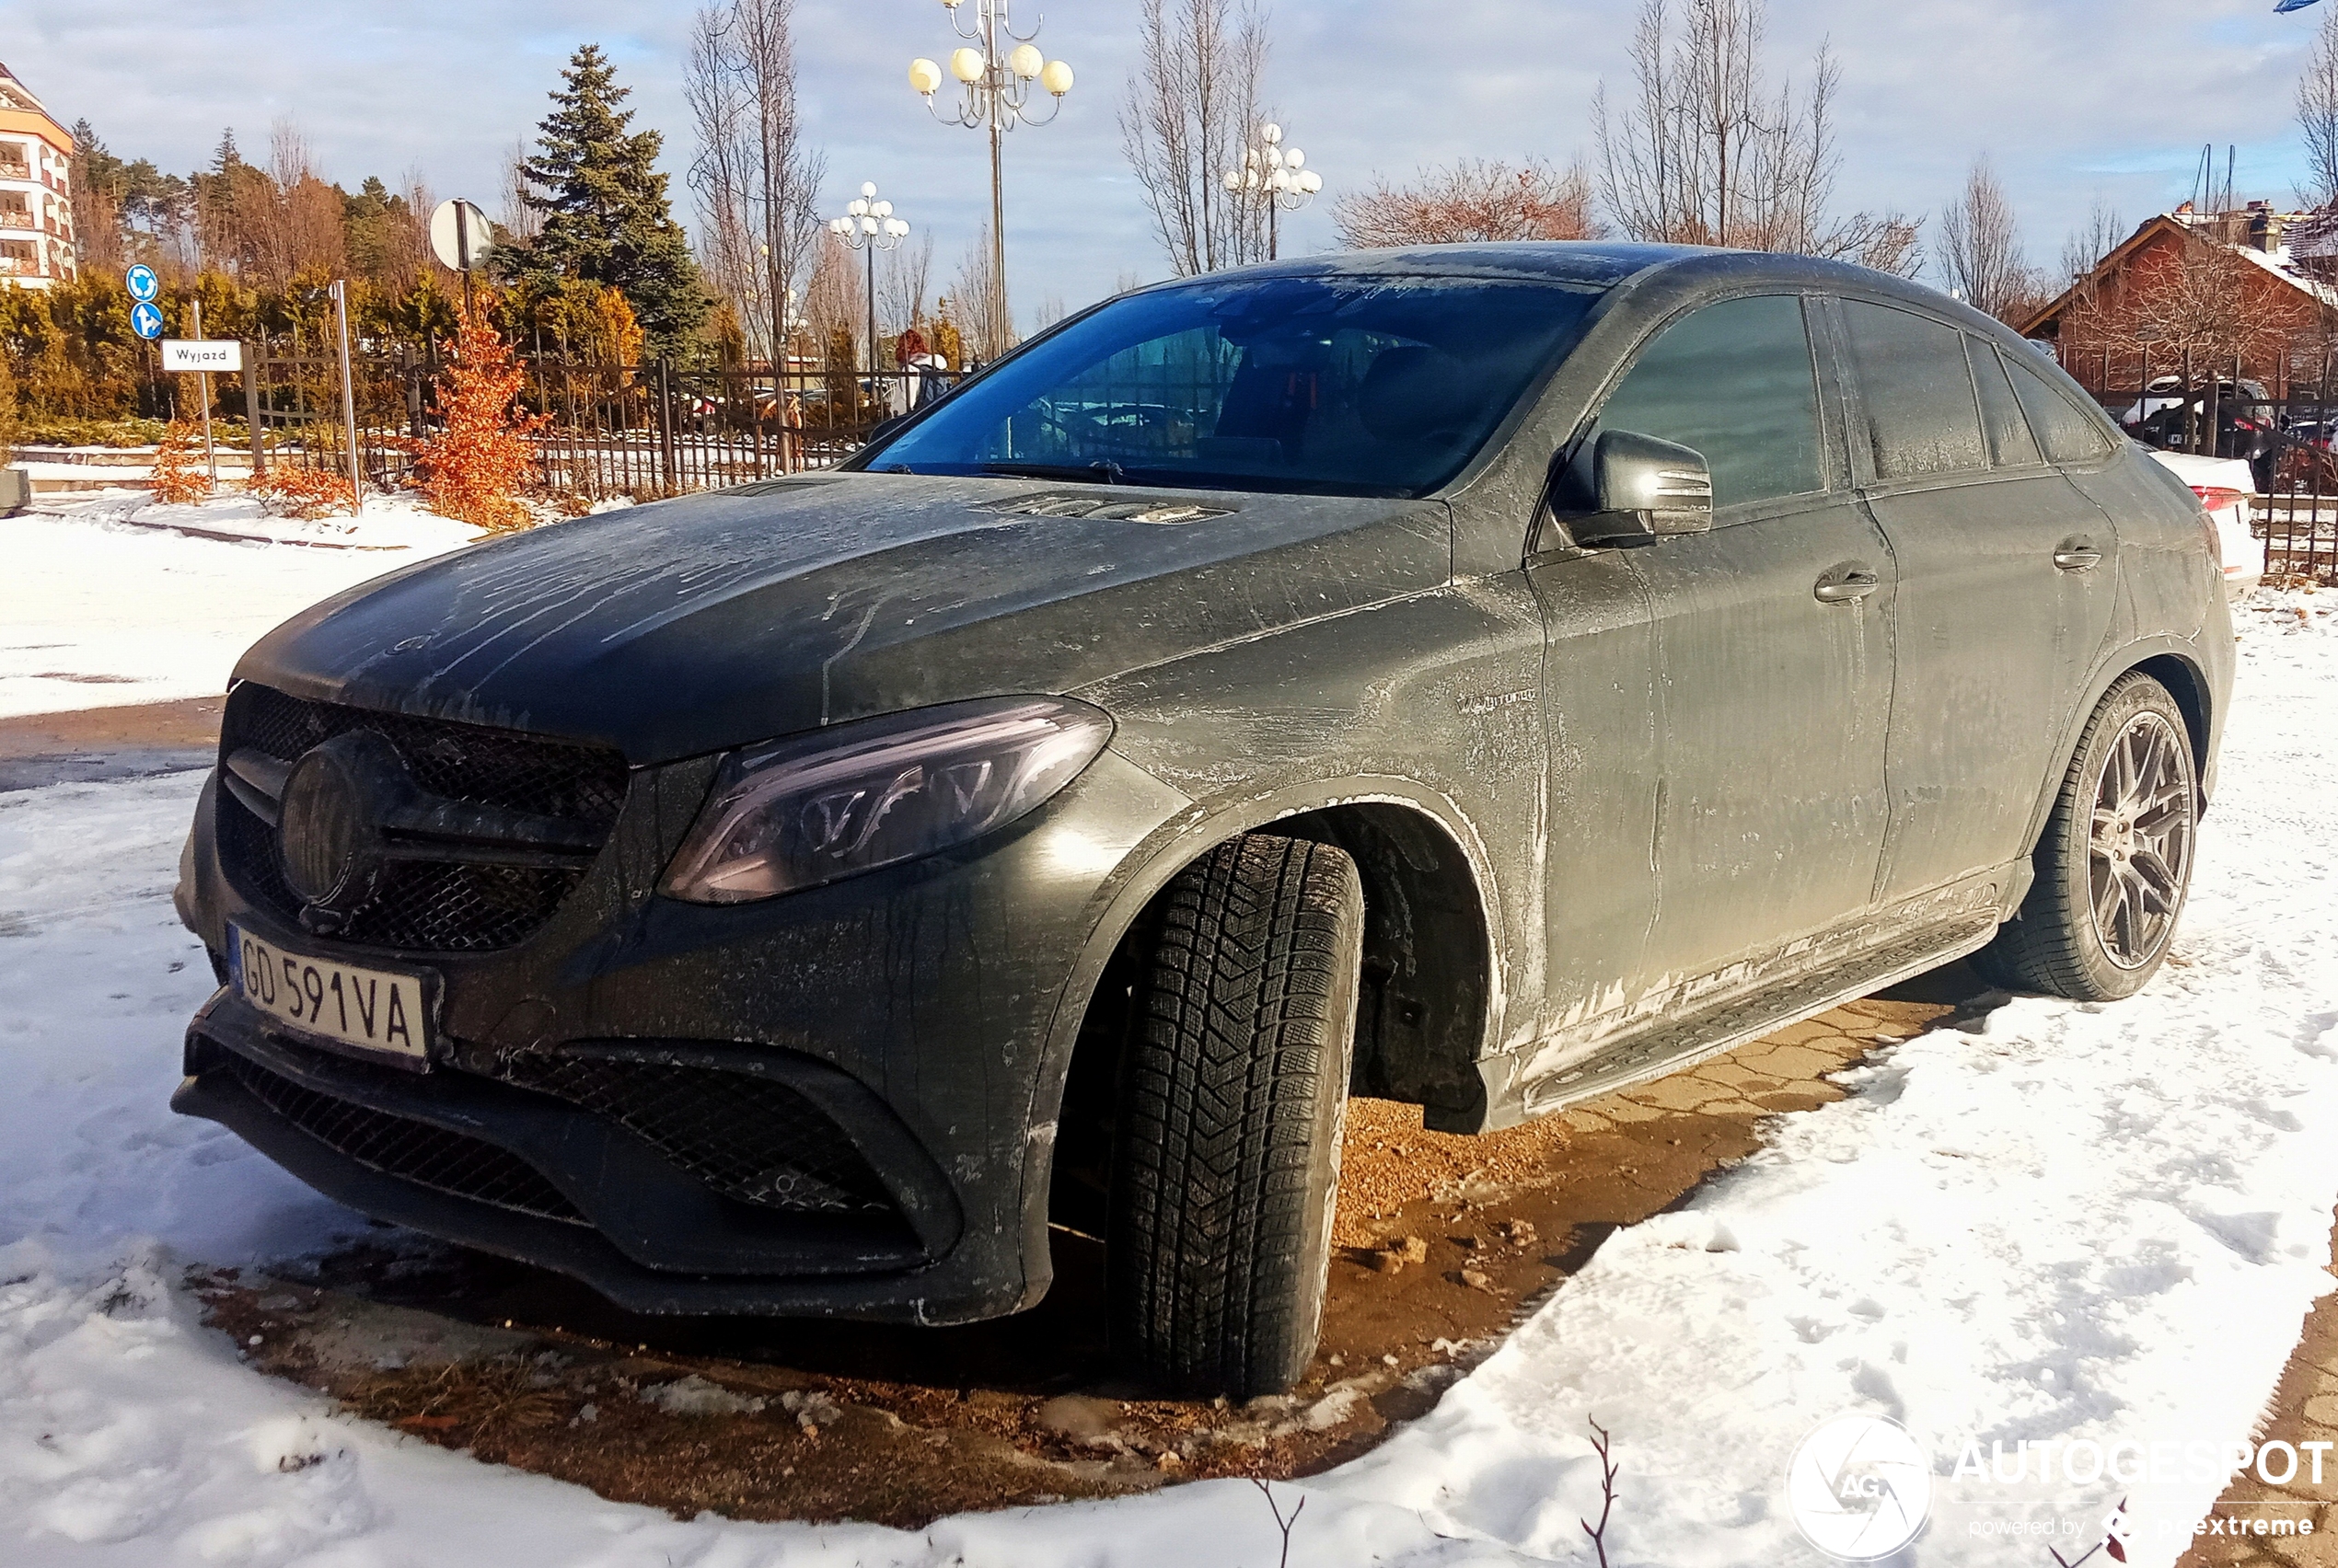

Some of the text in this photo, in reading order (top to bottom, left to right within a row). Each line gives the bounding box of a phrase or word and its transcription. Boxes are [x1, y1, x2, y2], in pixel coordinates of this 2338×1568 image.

[176, 349, 226, 363] Wyjazd
[243, 939, 411, 1047] GD 591VA
